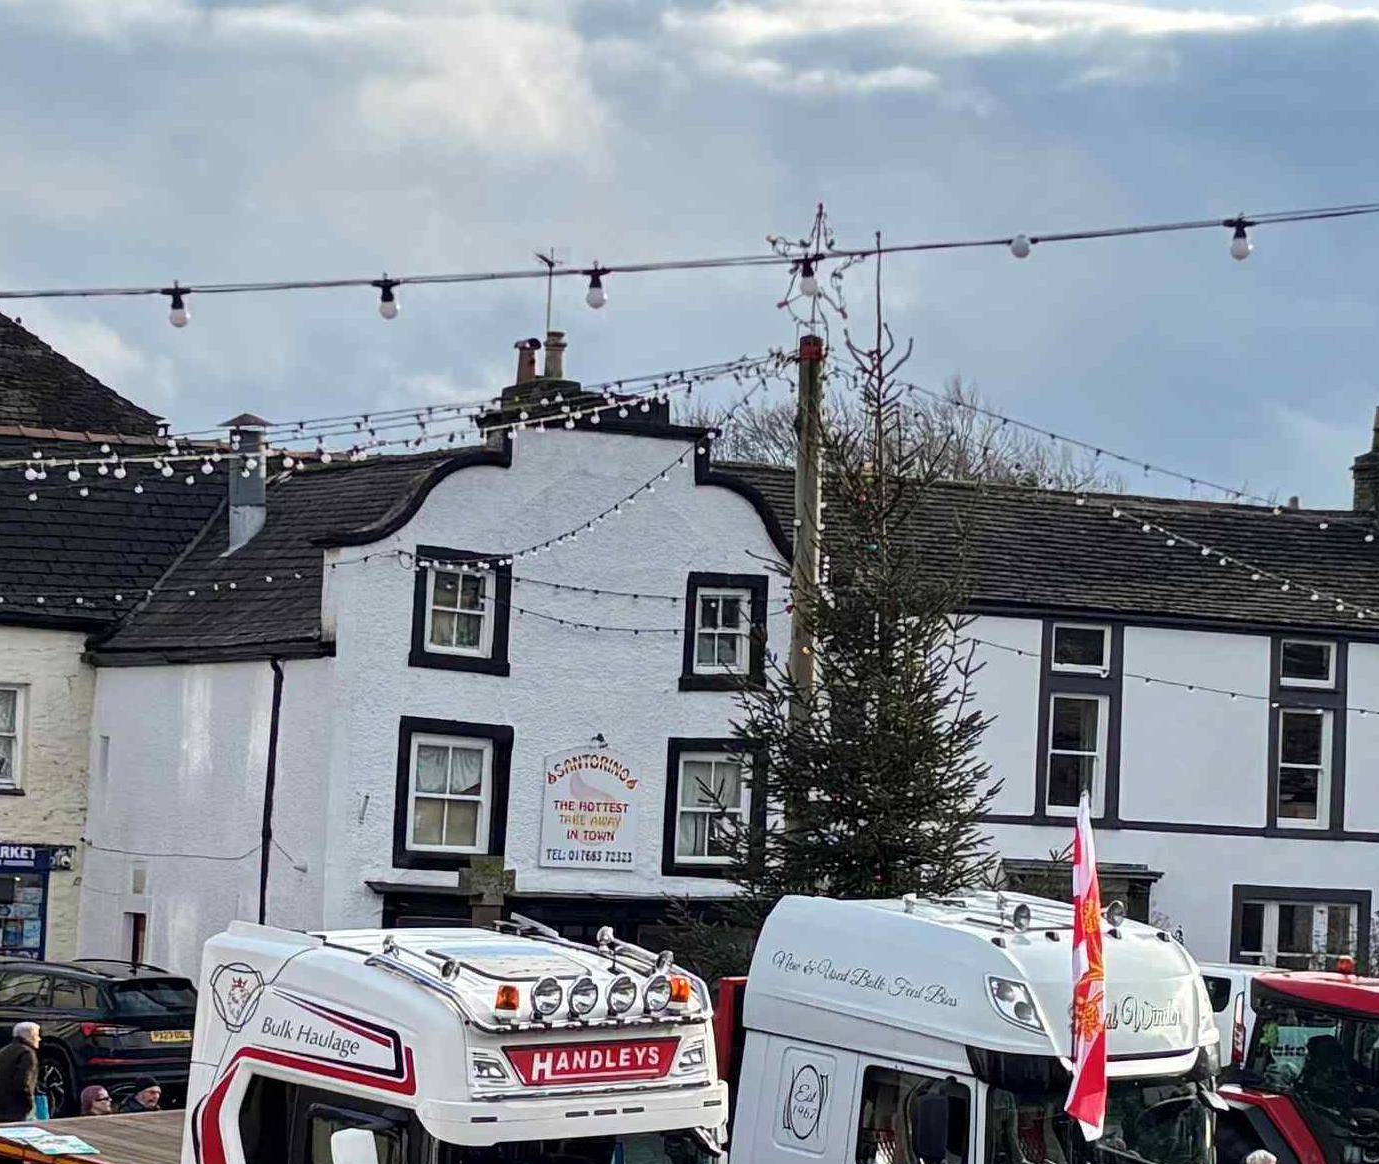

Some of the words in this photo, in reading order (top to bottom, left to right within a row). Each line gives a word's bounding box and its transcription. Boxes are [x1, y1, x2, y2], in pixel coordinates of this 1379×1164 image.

[554, 754, 630, 781] SANTORINO
[553, 800, 575, 811] THE
[579, 801, 629, 813] HOTTEST
[590, 816, 622, 828] AWAY
[567, 830, 578, 840] IN
[584, 831, 615, 841] TOWN
[1121, 996, 1183, 1032] Winder
[261, 1016, 292, 1040] Bulk
[297, 1024, 360, 1058] Haulage
[531, 1046, 660, 1081] HANDLEYS
[795, 1084, 817, 1103] Est
